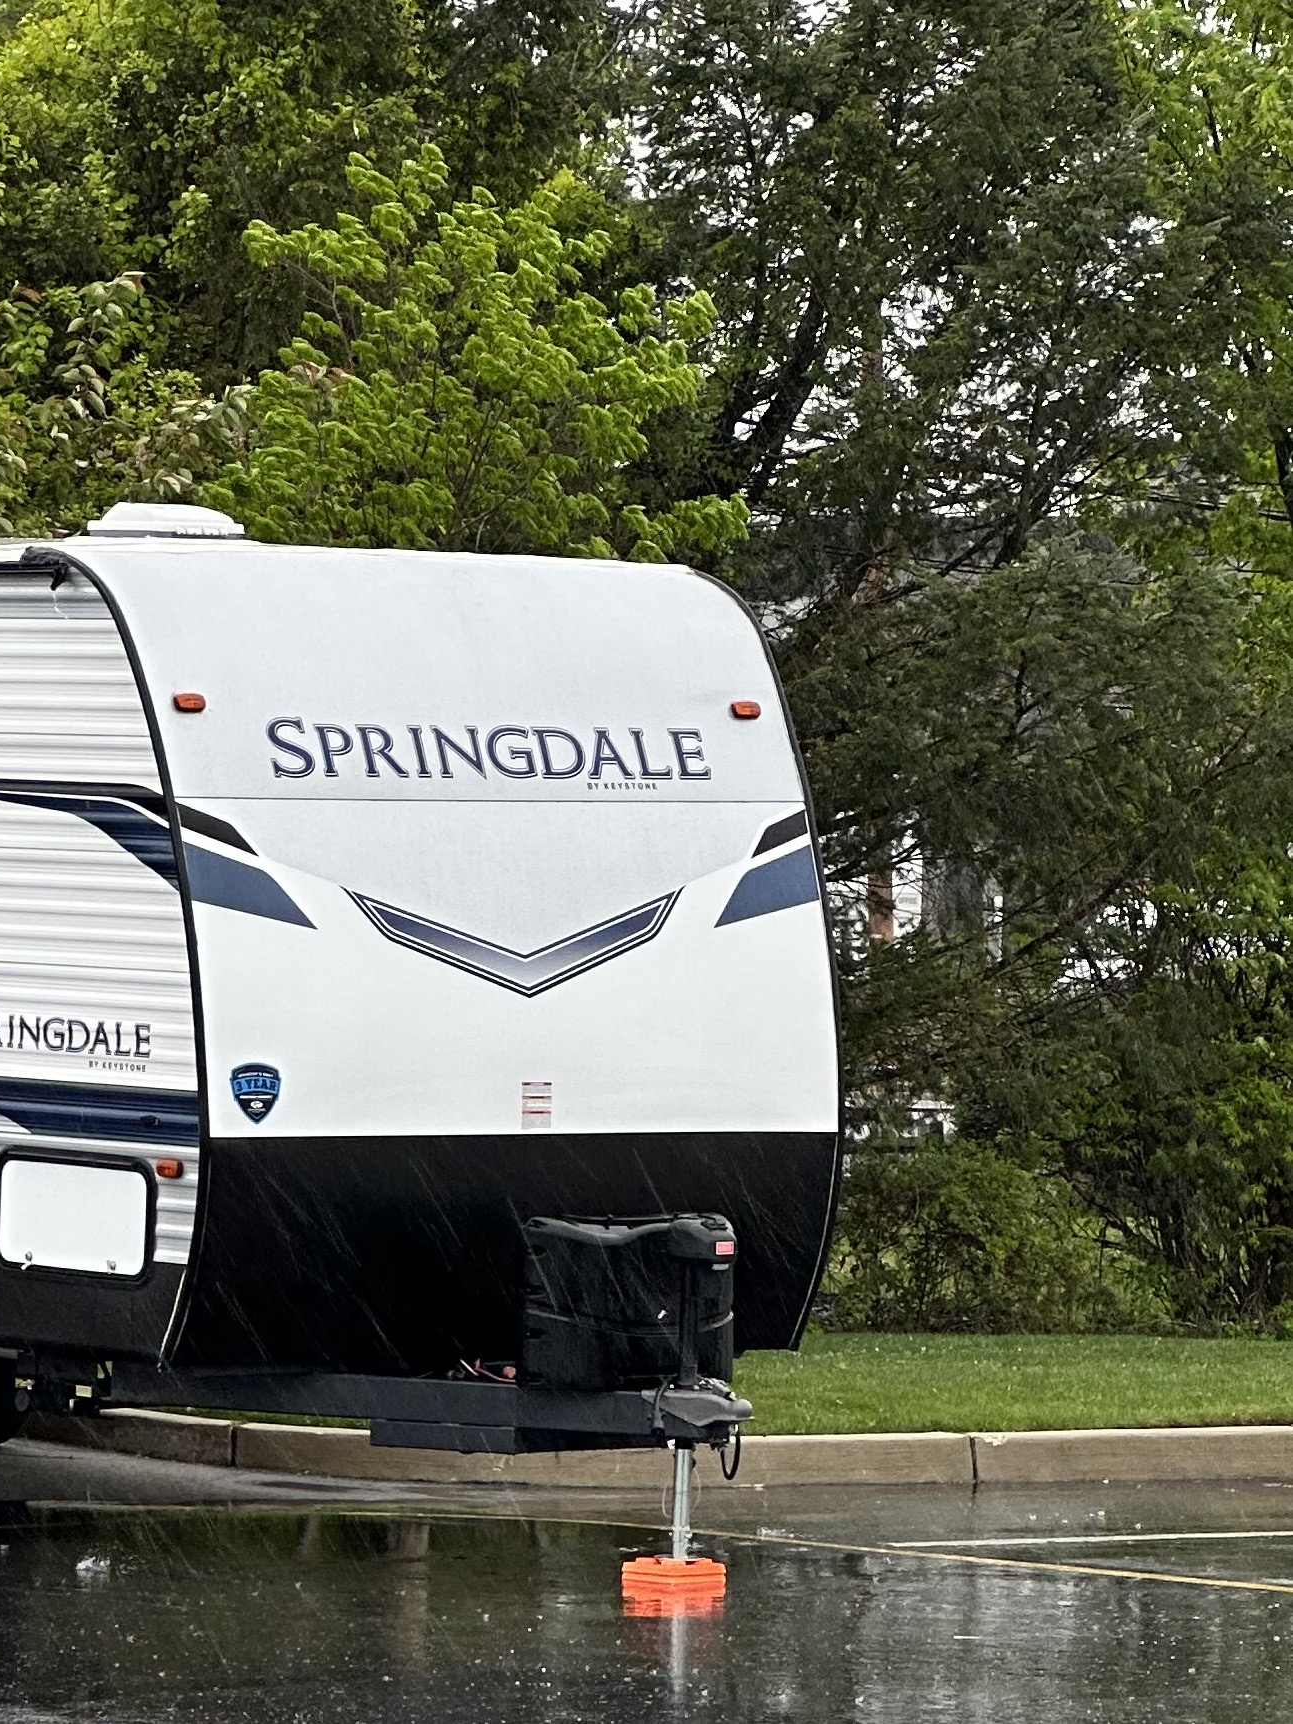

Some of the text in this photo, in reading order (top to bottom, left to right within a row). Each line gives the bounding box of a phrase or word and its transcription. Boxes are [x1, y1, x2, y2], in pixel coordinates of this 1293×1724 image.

[266, 716, 711, 780] SPRINGDALE
[587, 782, 658, 790] BY KEYSTONE
[88, 1060, 146, 1072] BY KEYSTONE
[235, 1078, 277, 1092] 3 YEAR
